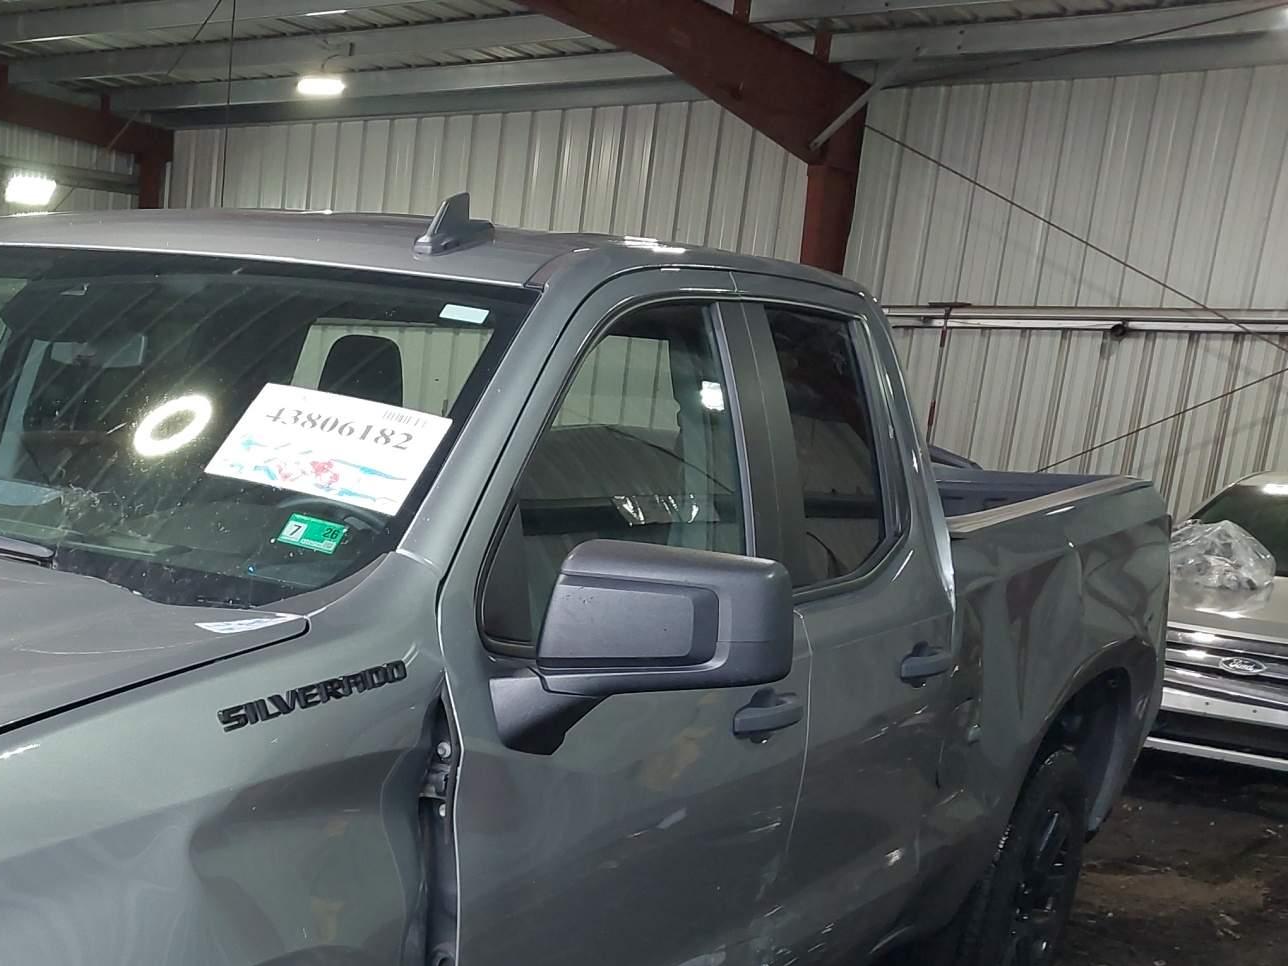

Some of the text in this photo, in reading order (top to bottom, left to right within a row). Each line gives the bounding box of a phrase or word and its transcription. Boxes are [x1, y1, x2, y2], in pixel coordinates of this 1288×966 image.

[265, 406, 414, 450] 43806182
[289, 523, 341, 541] 7 26
[217, 659, 408, 733] SILVERADO
